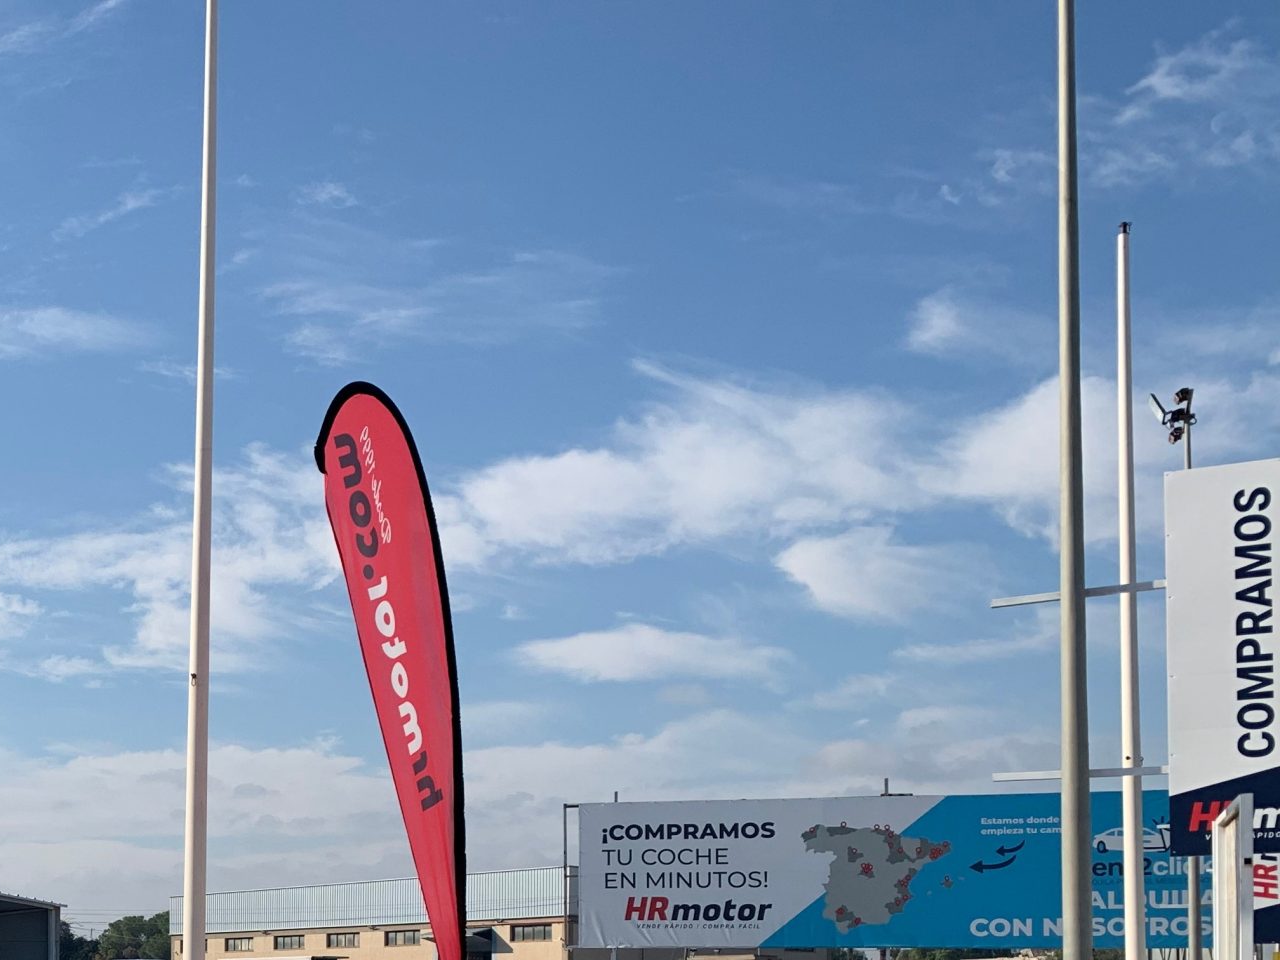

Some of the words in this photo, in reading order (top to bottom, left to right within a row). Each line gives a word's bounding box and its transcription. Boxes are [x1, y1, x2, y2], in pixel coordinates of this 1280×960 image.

[1233, 486, 1276, 758] COMPRAMOS
[981, 817, 1024, 825] Estamos
[1026, 816, 1060, 824] donde
[602, 822, 776, 844] ¡COMPRAMOS
[981, 828, 1023, 836] empieza
[602, 849, 633, 866] TU
[641, 848, 729, 865] COCHE
[605, 872, 636, 889] EN
[646, 871, 768, 889] MINUTOS!
[970, 918, 1033, 937] CON
